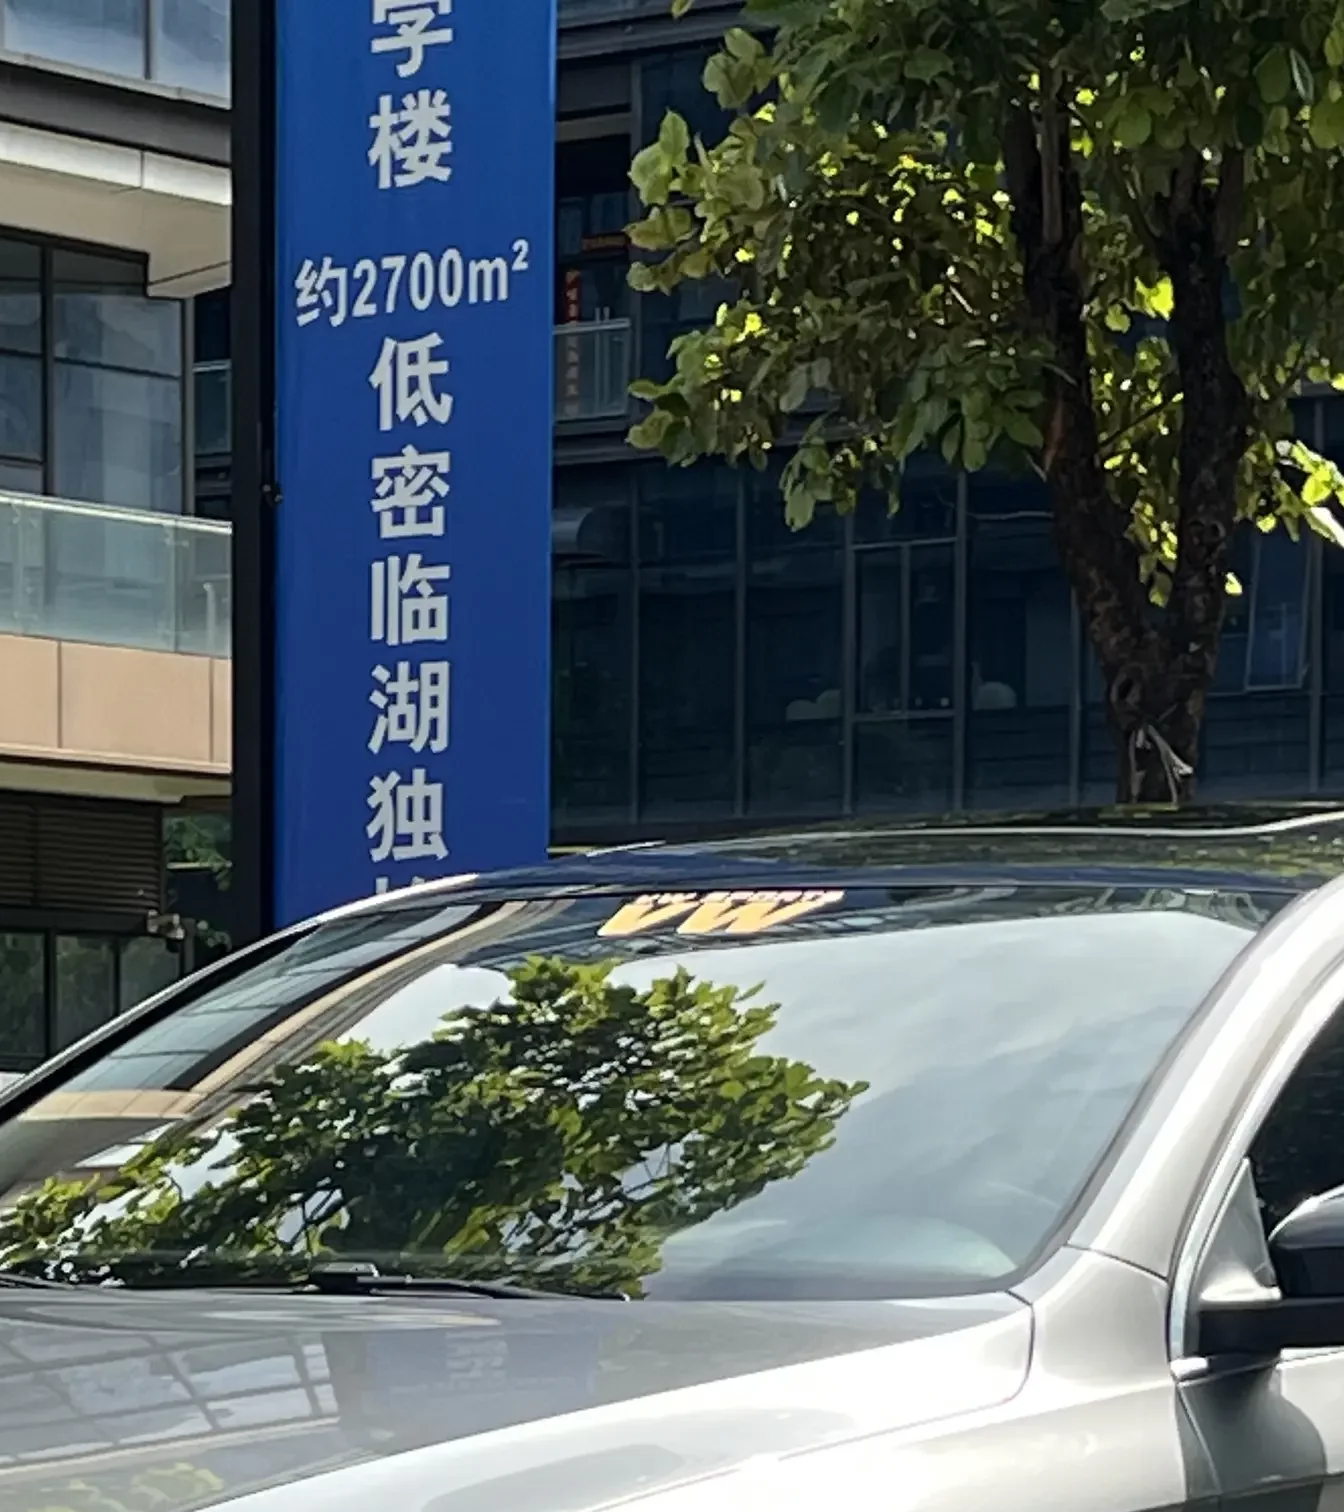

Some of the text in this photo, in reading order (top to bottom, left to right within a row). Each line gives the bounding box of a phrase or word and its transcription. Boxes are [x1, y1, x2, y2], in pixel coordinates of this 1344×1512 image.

[367, 0, 454, 190] 字楼
[367, 332, 453, 893] 低密临湖独
